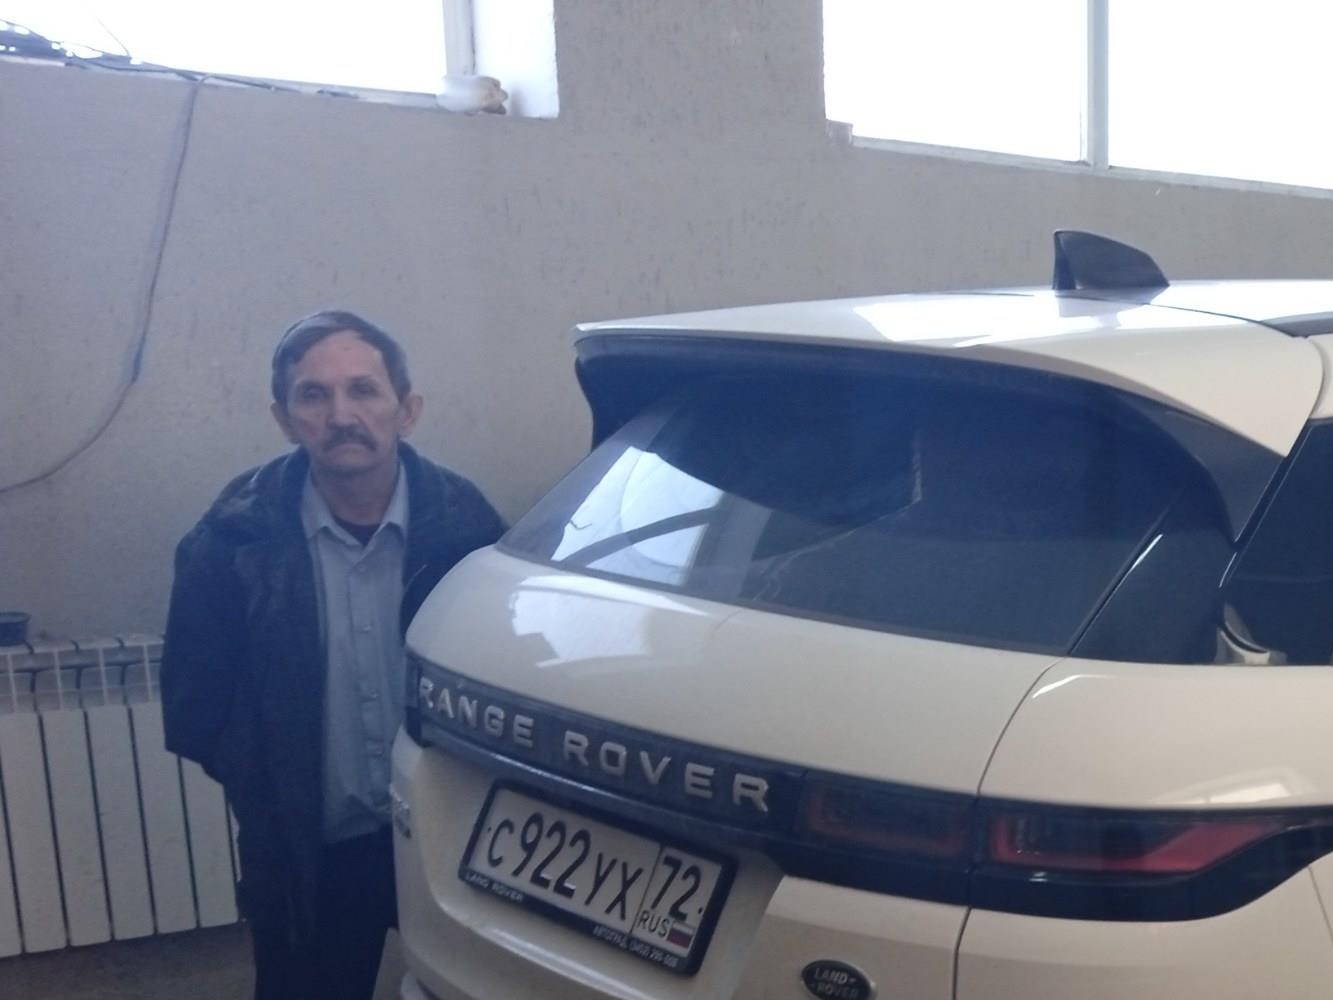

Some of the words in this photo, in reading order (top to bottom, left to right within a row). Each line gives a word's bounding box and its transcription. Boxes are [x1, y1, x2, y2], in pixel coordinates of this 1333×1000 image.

[419, 676, 535, 748] RANGE
[563, 730, 770, 812] ROVER
[650, 855, 701, 922] 72
[638, 910, 670, 938] RUS
